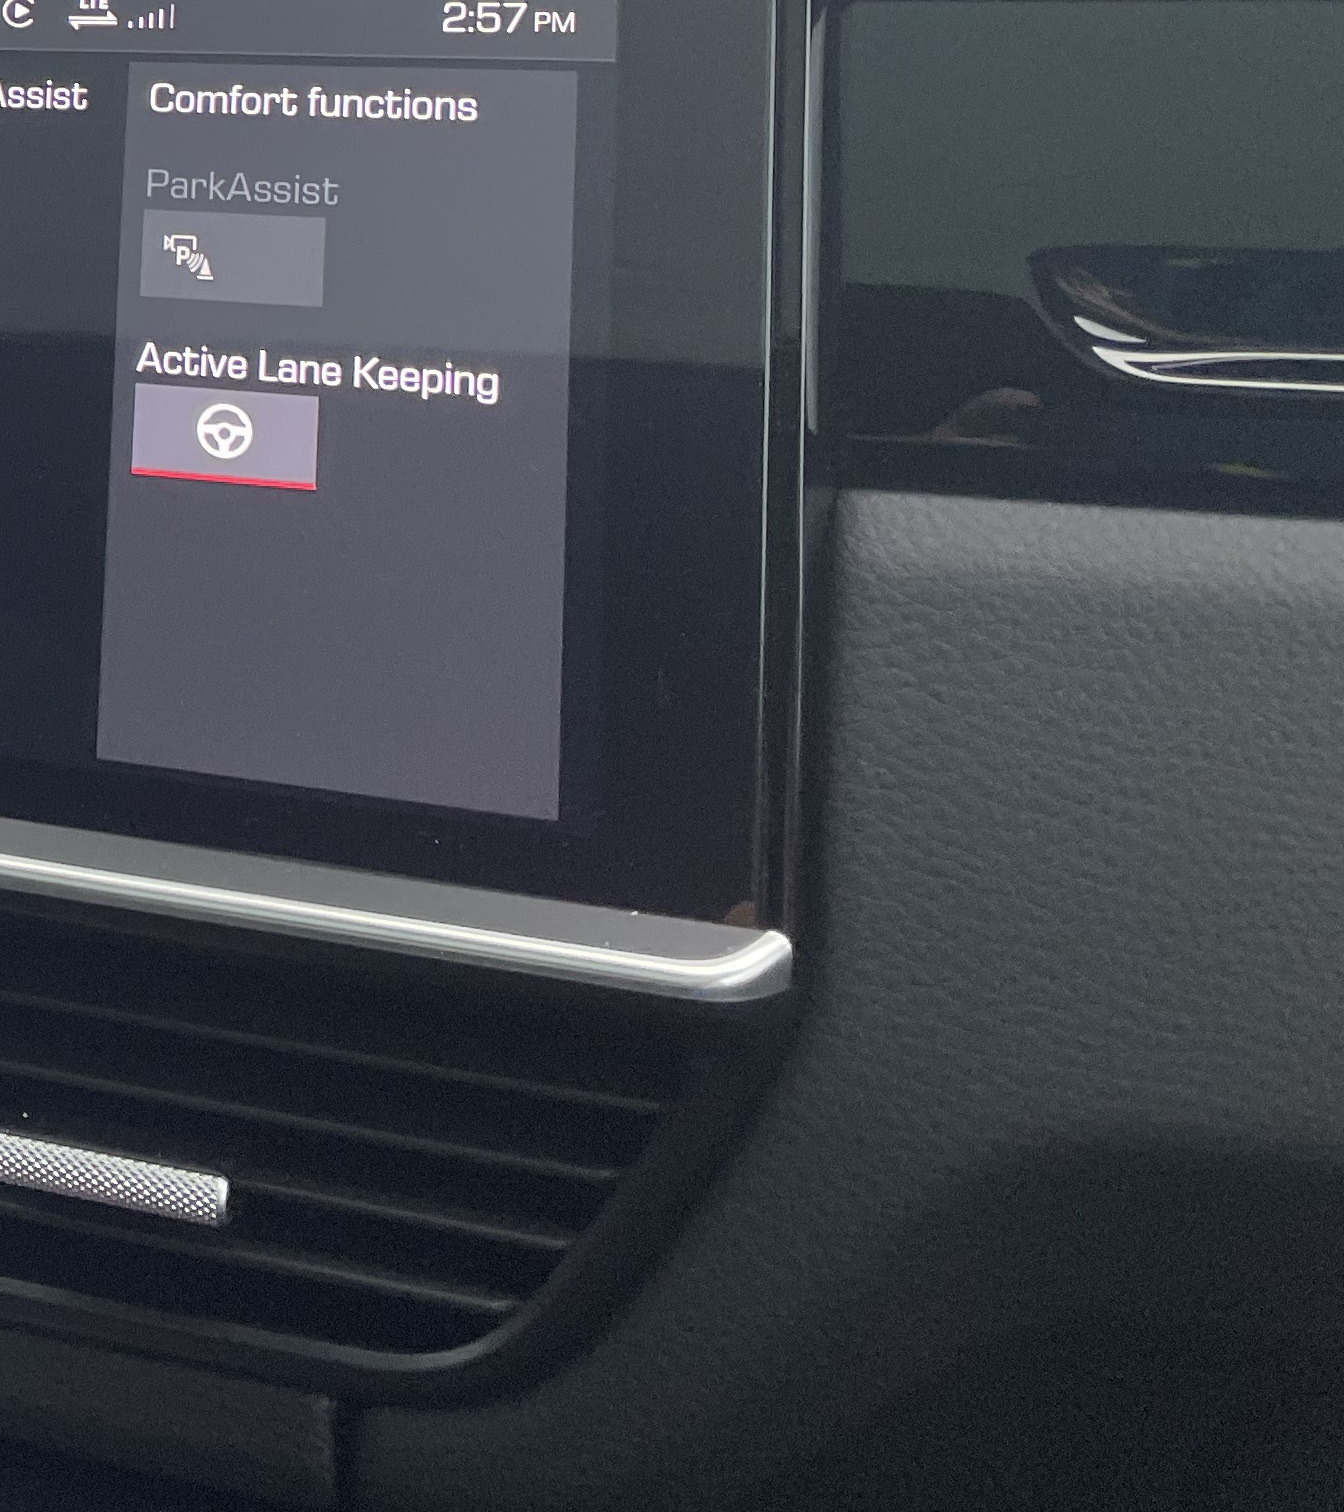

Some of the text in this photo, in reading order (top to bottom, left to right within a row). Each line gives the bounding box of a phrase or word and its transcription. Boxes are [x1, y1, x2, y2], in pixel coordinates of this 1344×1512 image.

[441, 1, 577, 35] 2:57 PM
[148, 82, 479, 122] Comfort functions
[145, 168, 340, 206] ParkAssist
[136, 342, 500, 405] Active Lane Keeping
